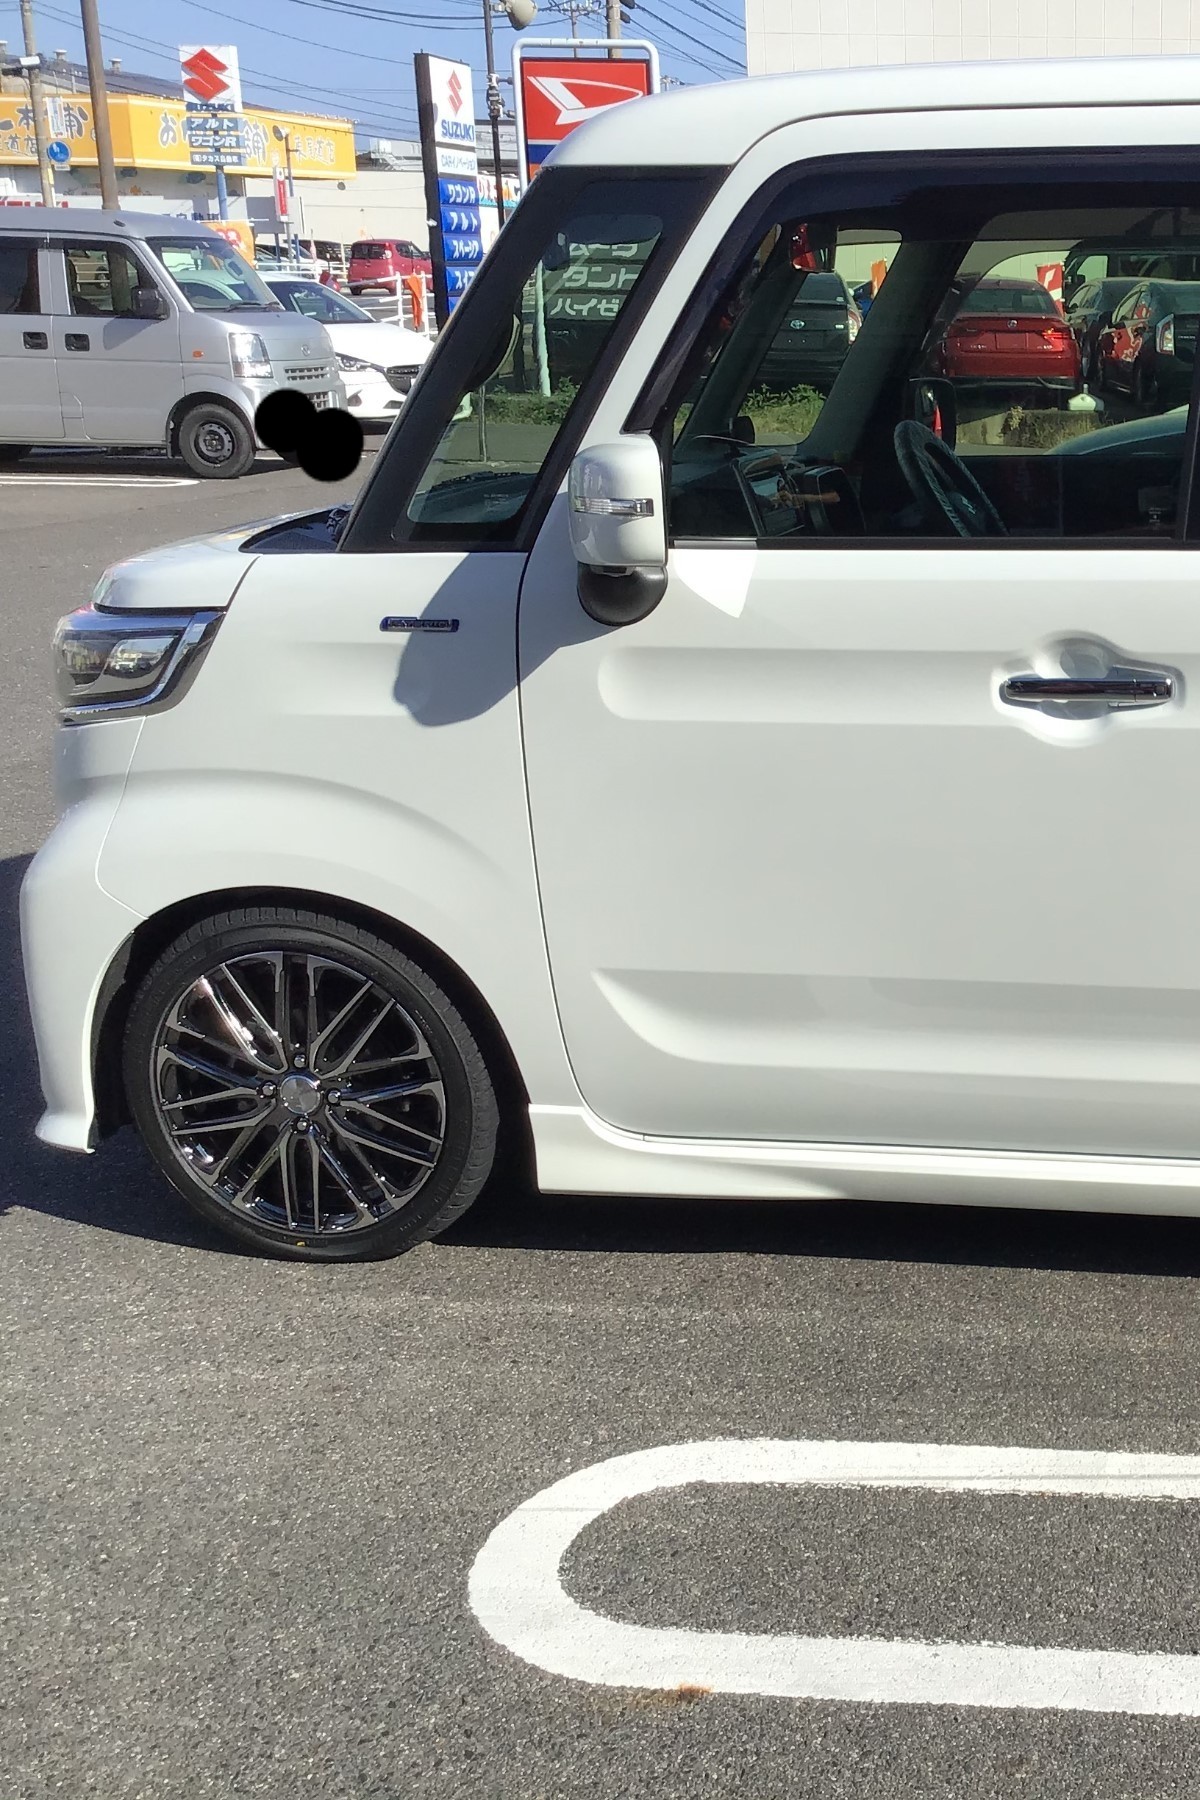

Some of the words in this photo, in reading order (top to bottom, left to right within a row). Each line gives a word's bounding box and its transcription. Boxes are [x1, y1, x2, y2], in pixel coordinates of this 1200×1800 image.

[190, 118, 235, 130] アルト
[441, 119, 475, 141] SUZUKI
[191, 135, 237, 147] ワゴンR
[447, 183, 476, 204] ワゴンR
[449, 211, 478, 232] アルト
[562, 265, 640, 288] タント
